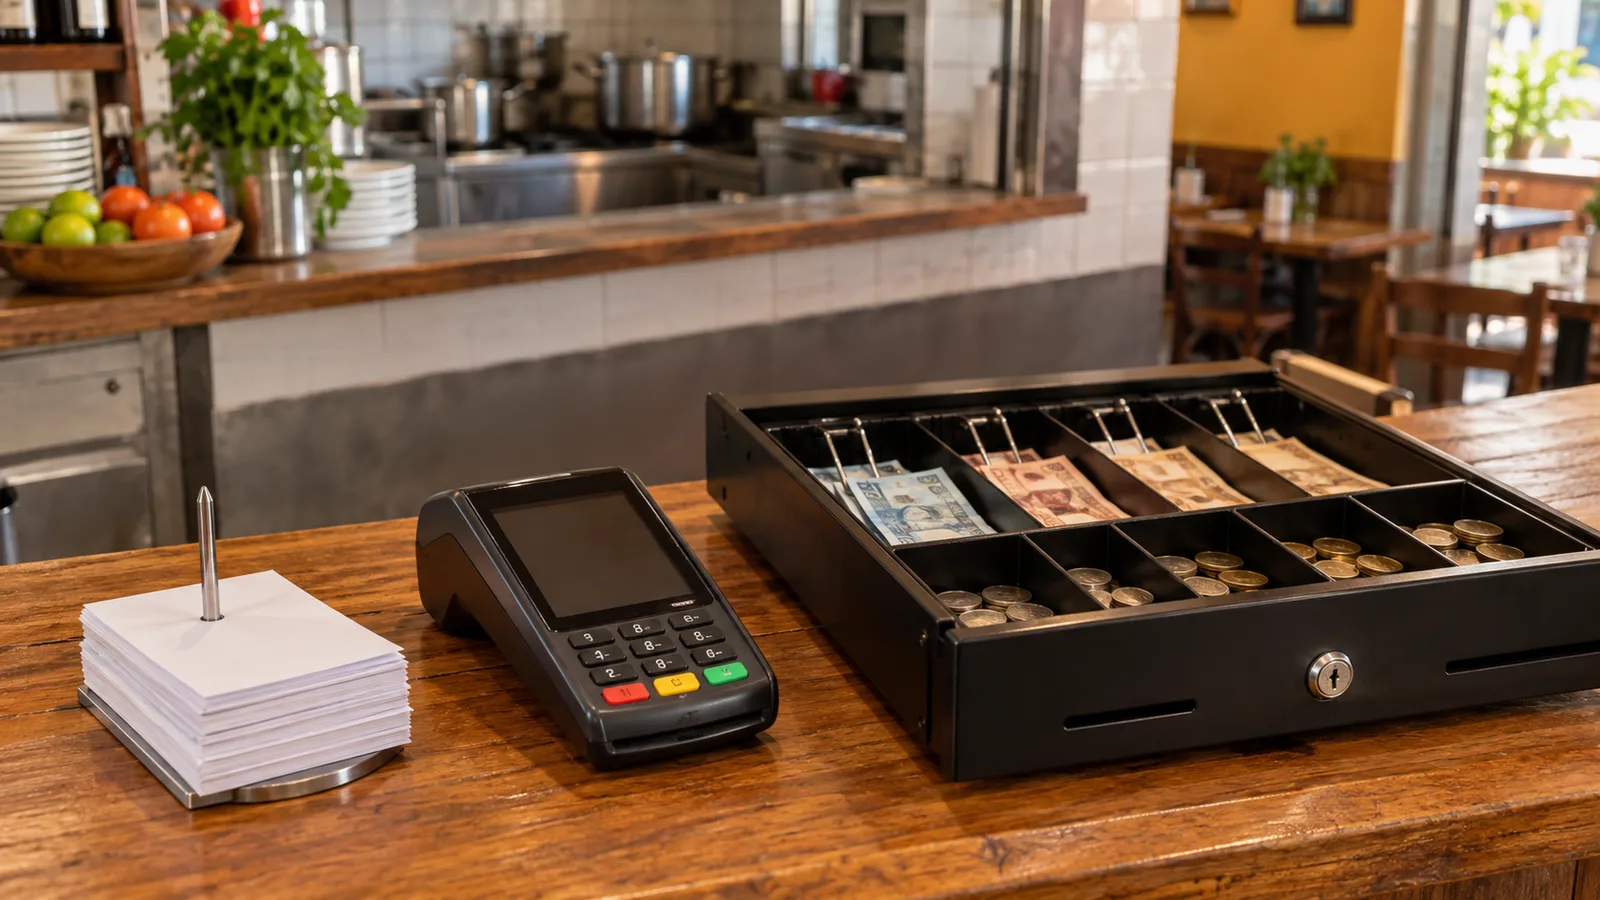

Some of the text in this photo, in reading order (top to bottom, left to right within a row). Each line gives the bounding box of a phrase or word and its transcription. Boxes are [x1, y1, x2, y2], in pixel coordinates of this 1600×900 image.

[633, 624, 643, 633] 8
[693, 631, 704, 641] 8
[644, 641, 655, 650] 8
[655, 659, 666, 669] 8
[605, 668, 616, 678] 2
